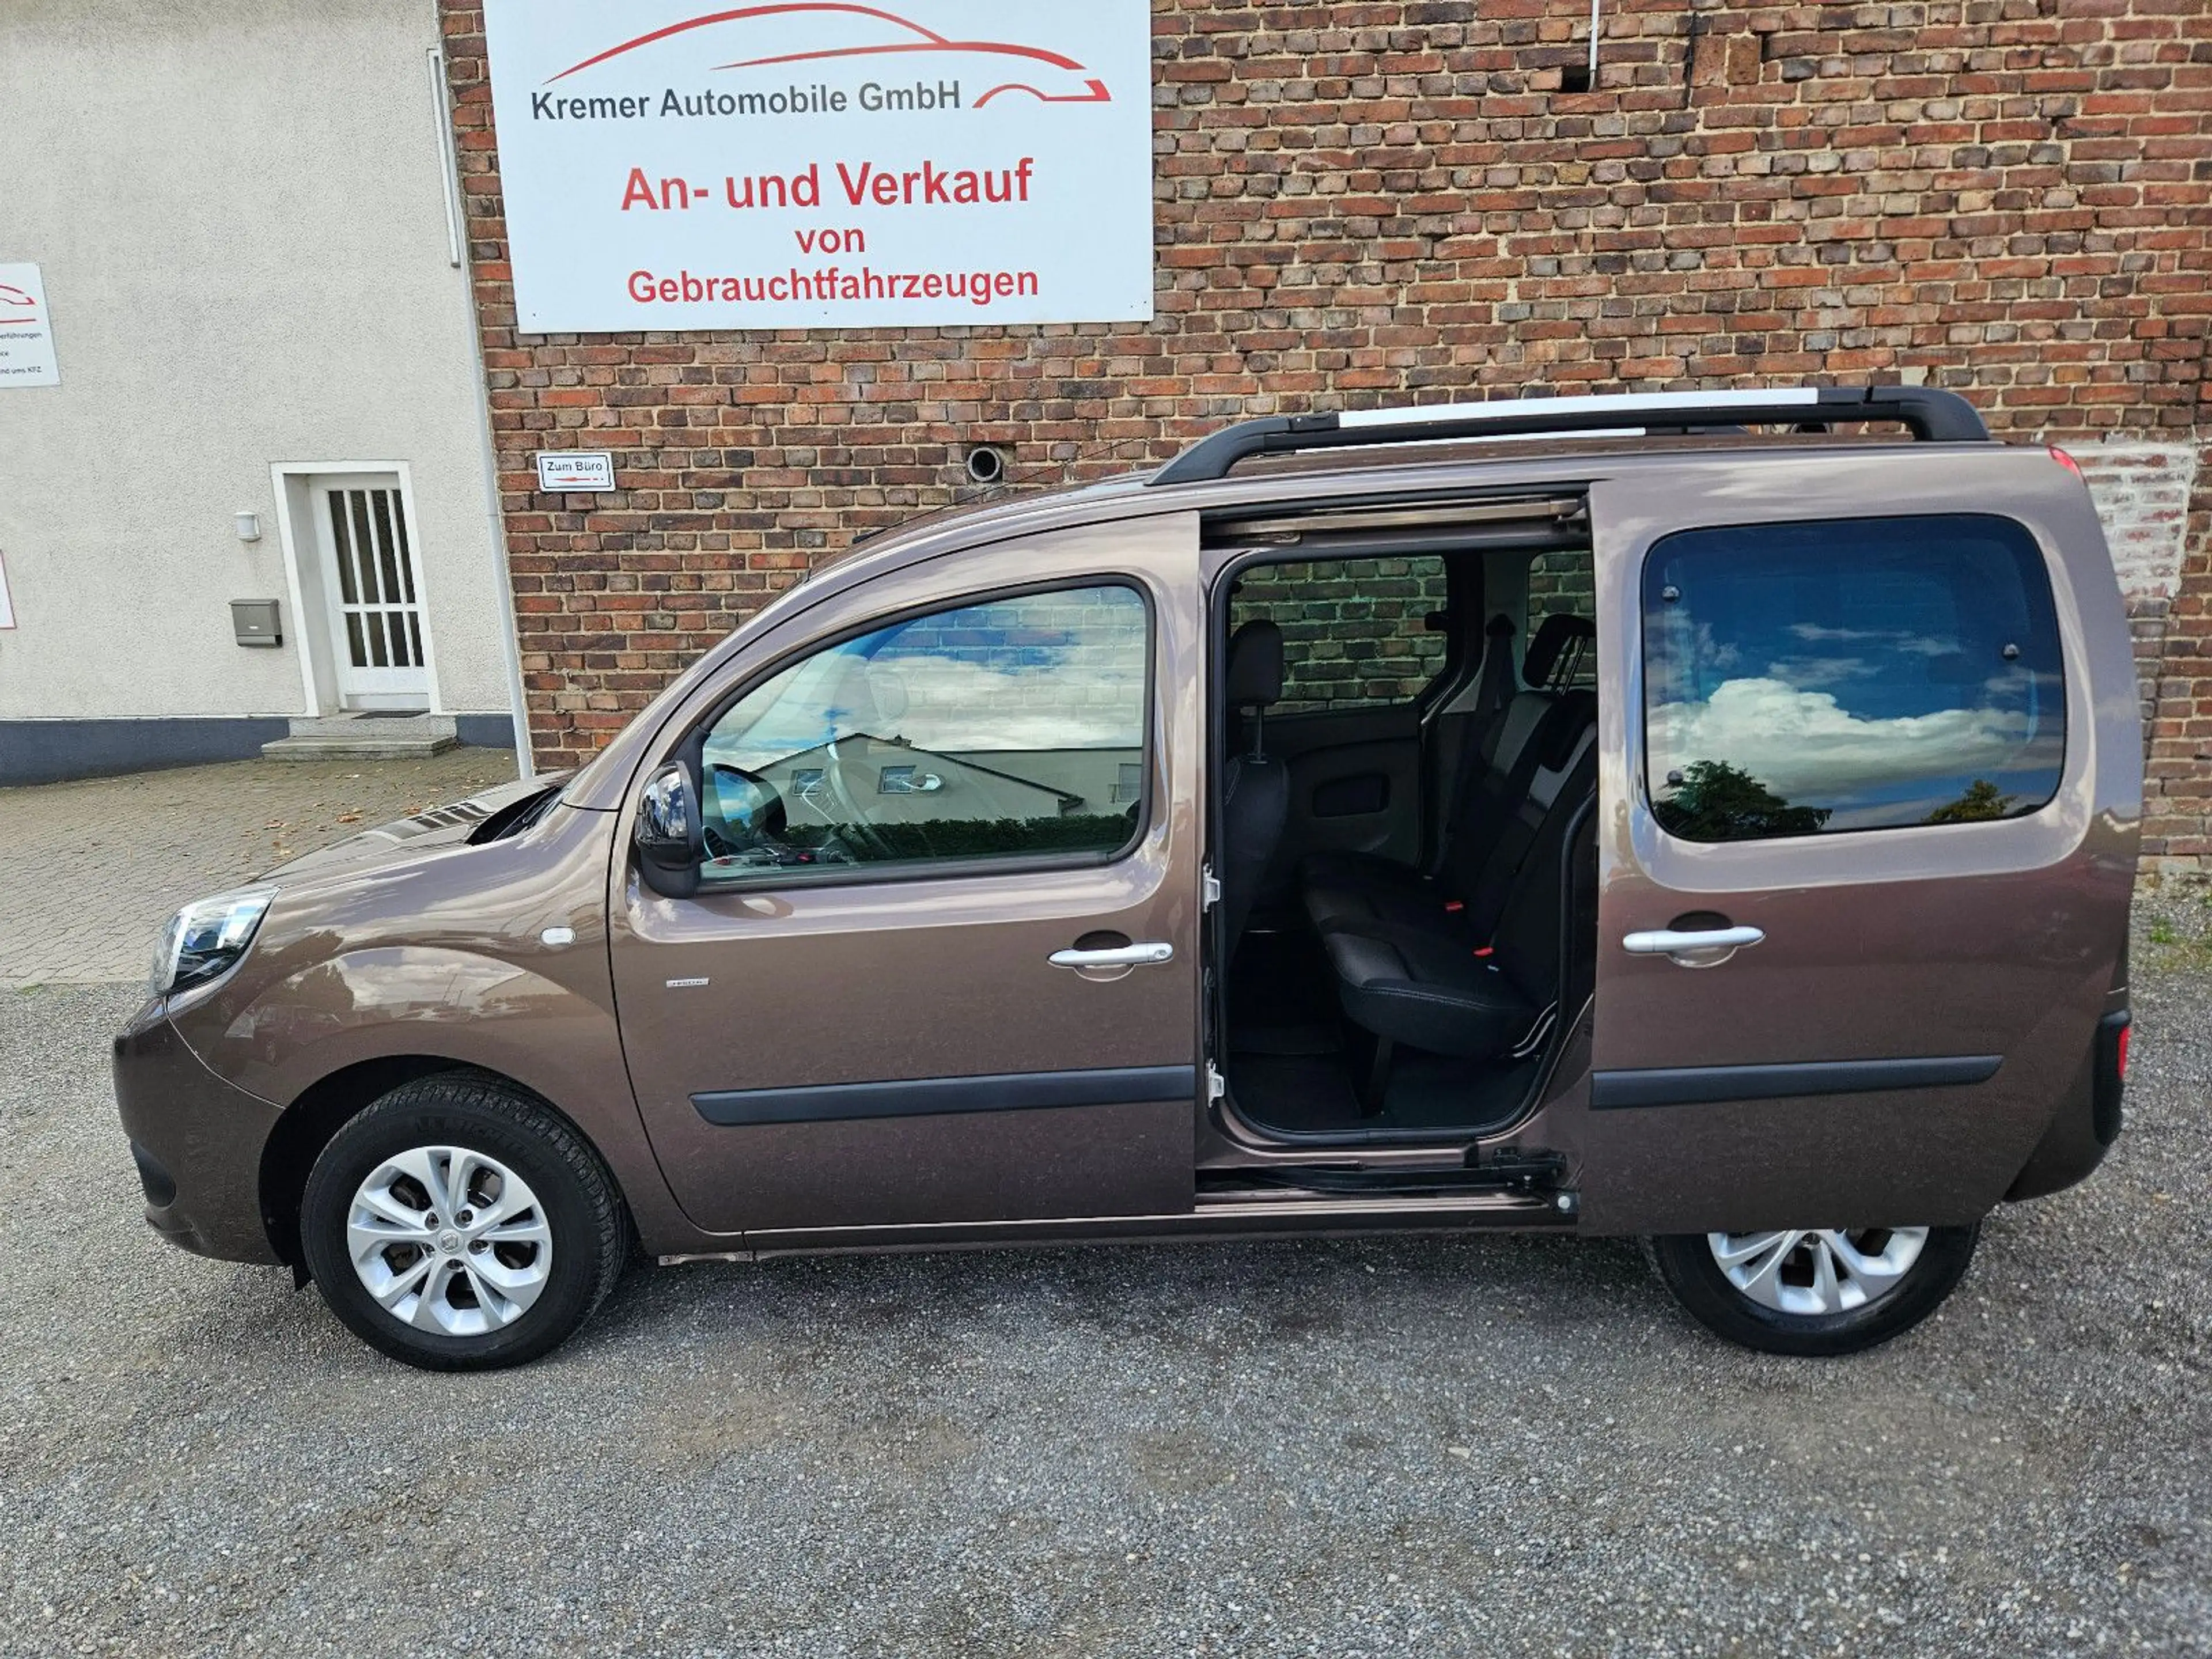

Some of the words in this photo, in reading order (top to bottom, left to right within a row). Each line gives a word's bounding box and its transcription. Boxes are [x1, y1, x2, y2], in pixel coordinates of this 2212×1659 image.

[531, 92, 650, 120] Kremer
[660, 84, 847, 117] Automobile
[859, 80, 960, 111] GmbH
[622, 168, 709, 211] An-
[726, 163, 820, 209] und
[836, 157, 1033, 206] Verkauf
[794, 229, 865, 254] von
[628, 267, 1038, 305] Gebrauchtfahrzeugen
[547, 461, 572, 471] Zum
[575, 461, 603, 471] Büro
